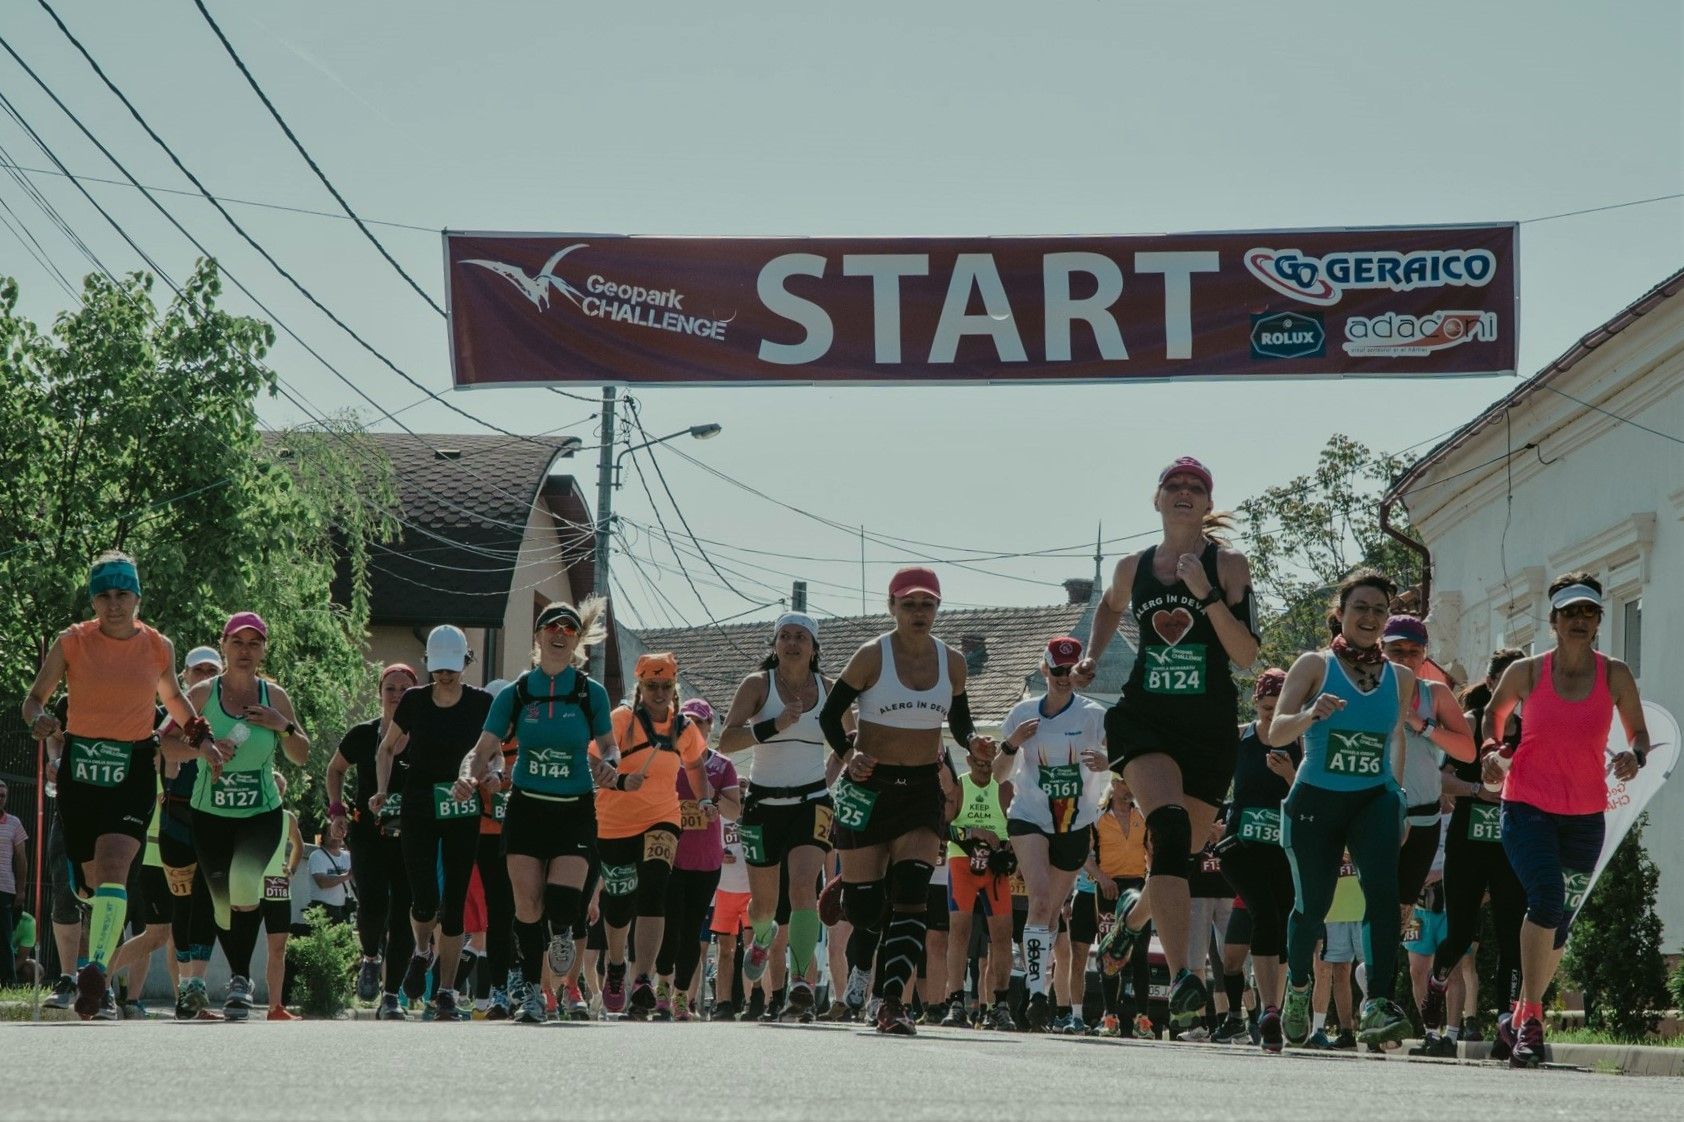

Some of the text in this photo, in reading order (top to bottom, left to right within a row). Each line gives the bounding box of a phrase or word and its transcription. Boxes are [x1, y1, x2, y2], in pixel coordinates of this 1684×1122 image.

[1325, 254, 1491, 285] GERAICO
[586, 274, 684, 311] Geopark
[757, 250, 1220, 365] START
[581, 296, 728, 341] CHALLENGE
[1349, 316, 1494, 338] adaconi
[1260, 330, 1315, 346] ROLUX
[1136, 597, 1163, 620] ALERG
[1181, 597, 1206, 616] DEVA
[1149, 670, 1200, 689] B124
[880, 701, 913, 714] ALERG
[529, 760, 570, 778] B144
[1329, 752, 1380, 773] A156
[76, 762, 125, 783] A116
[214, 790, 258, 806] B127
[1042, 782, 1078, 797] B161
[439, 799, 477, 816] B155
[969, 803, 990, 811] KEEP
[1242, 823, 1280, 842] B139
[265, 887, 288, 897] D118
[1027, 938, 1047, 982] eleven
